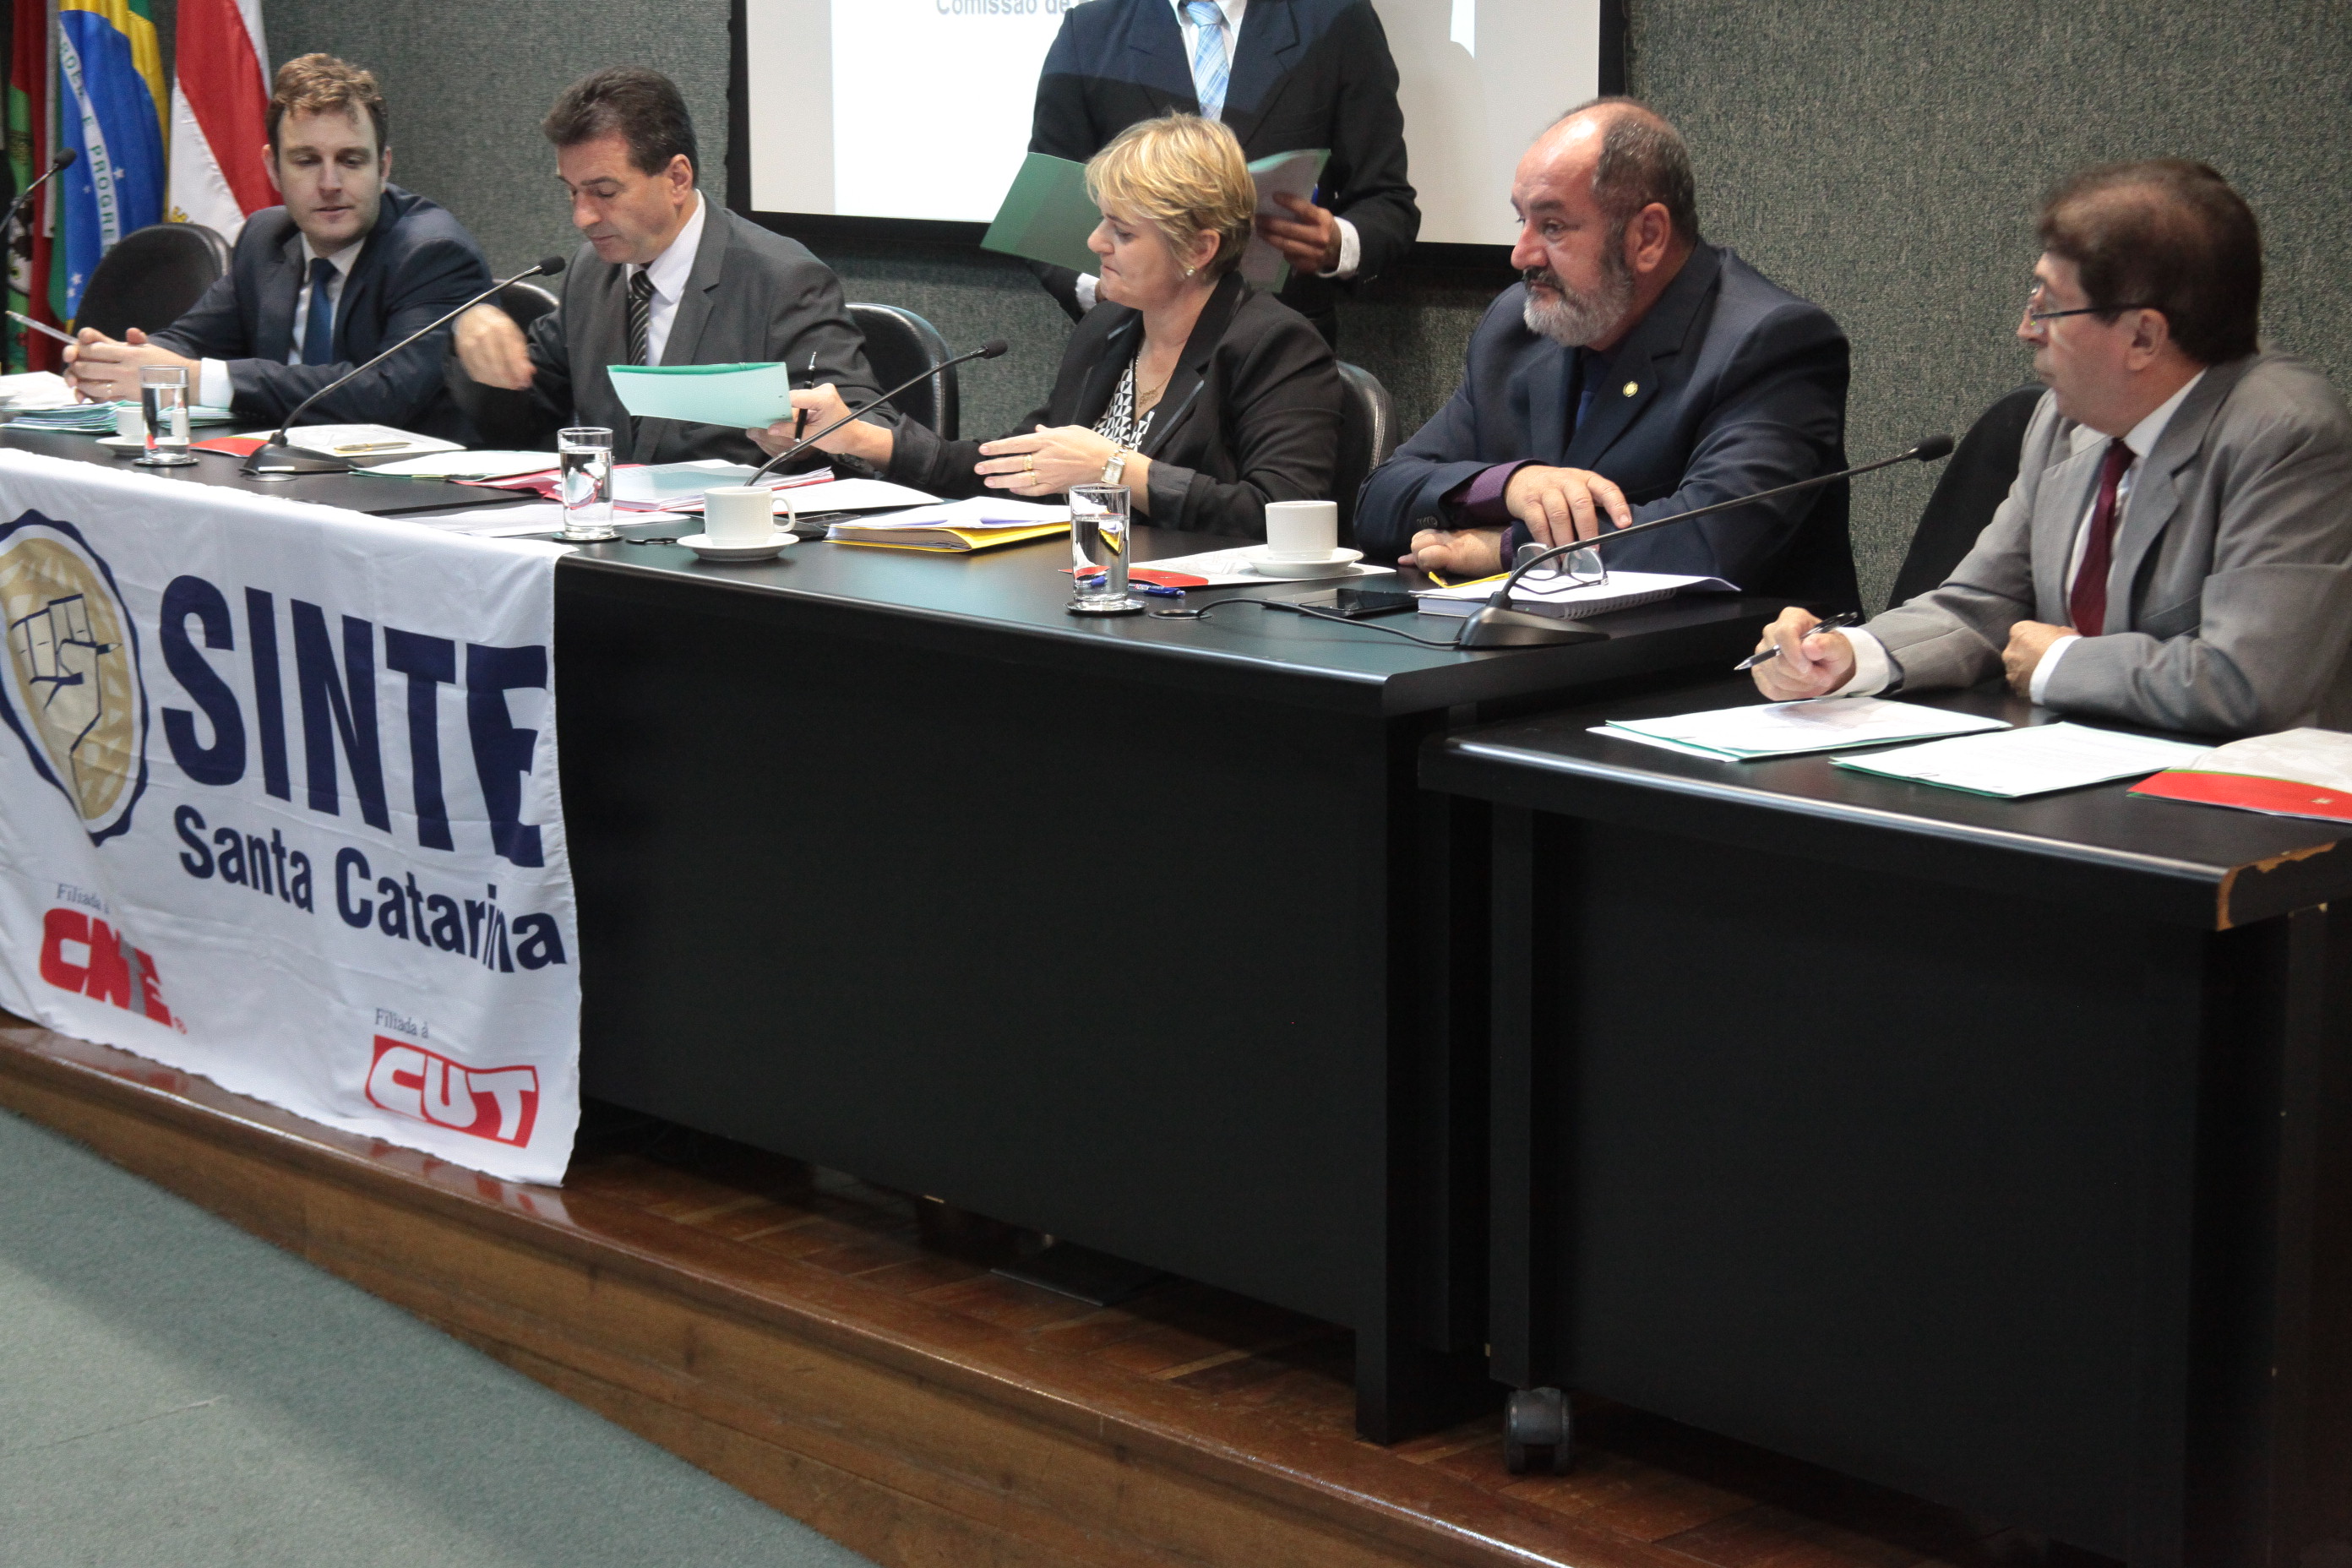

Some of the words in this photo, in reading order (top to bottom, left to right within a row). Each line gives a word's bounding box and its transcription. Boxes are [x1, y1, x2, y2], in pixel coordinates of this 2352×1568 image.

[160, 574, 548, 868] SINTE
[174, 804, 315, 914] Santa
[335, 847, 569, 974] Catarina
[374, 1007, 418, 1037] Filiada
[368, 1045, 536, 1141] CUT
